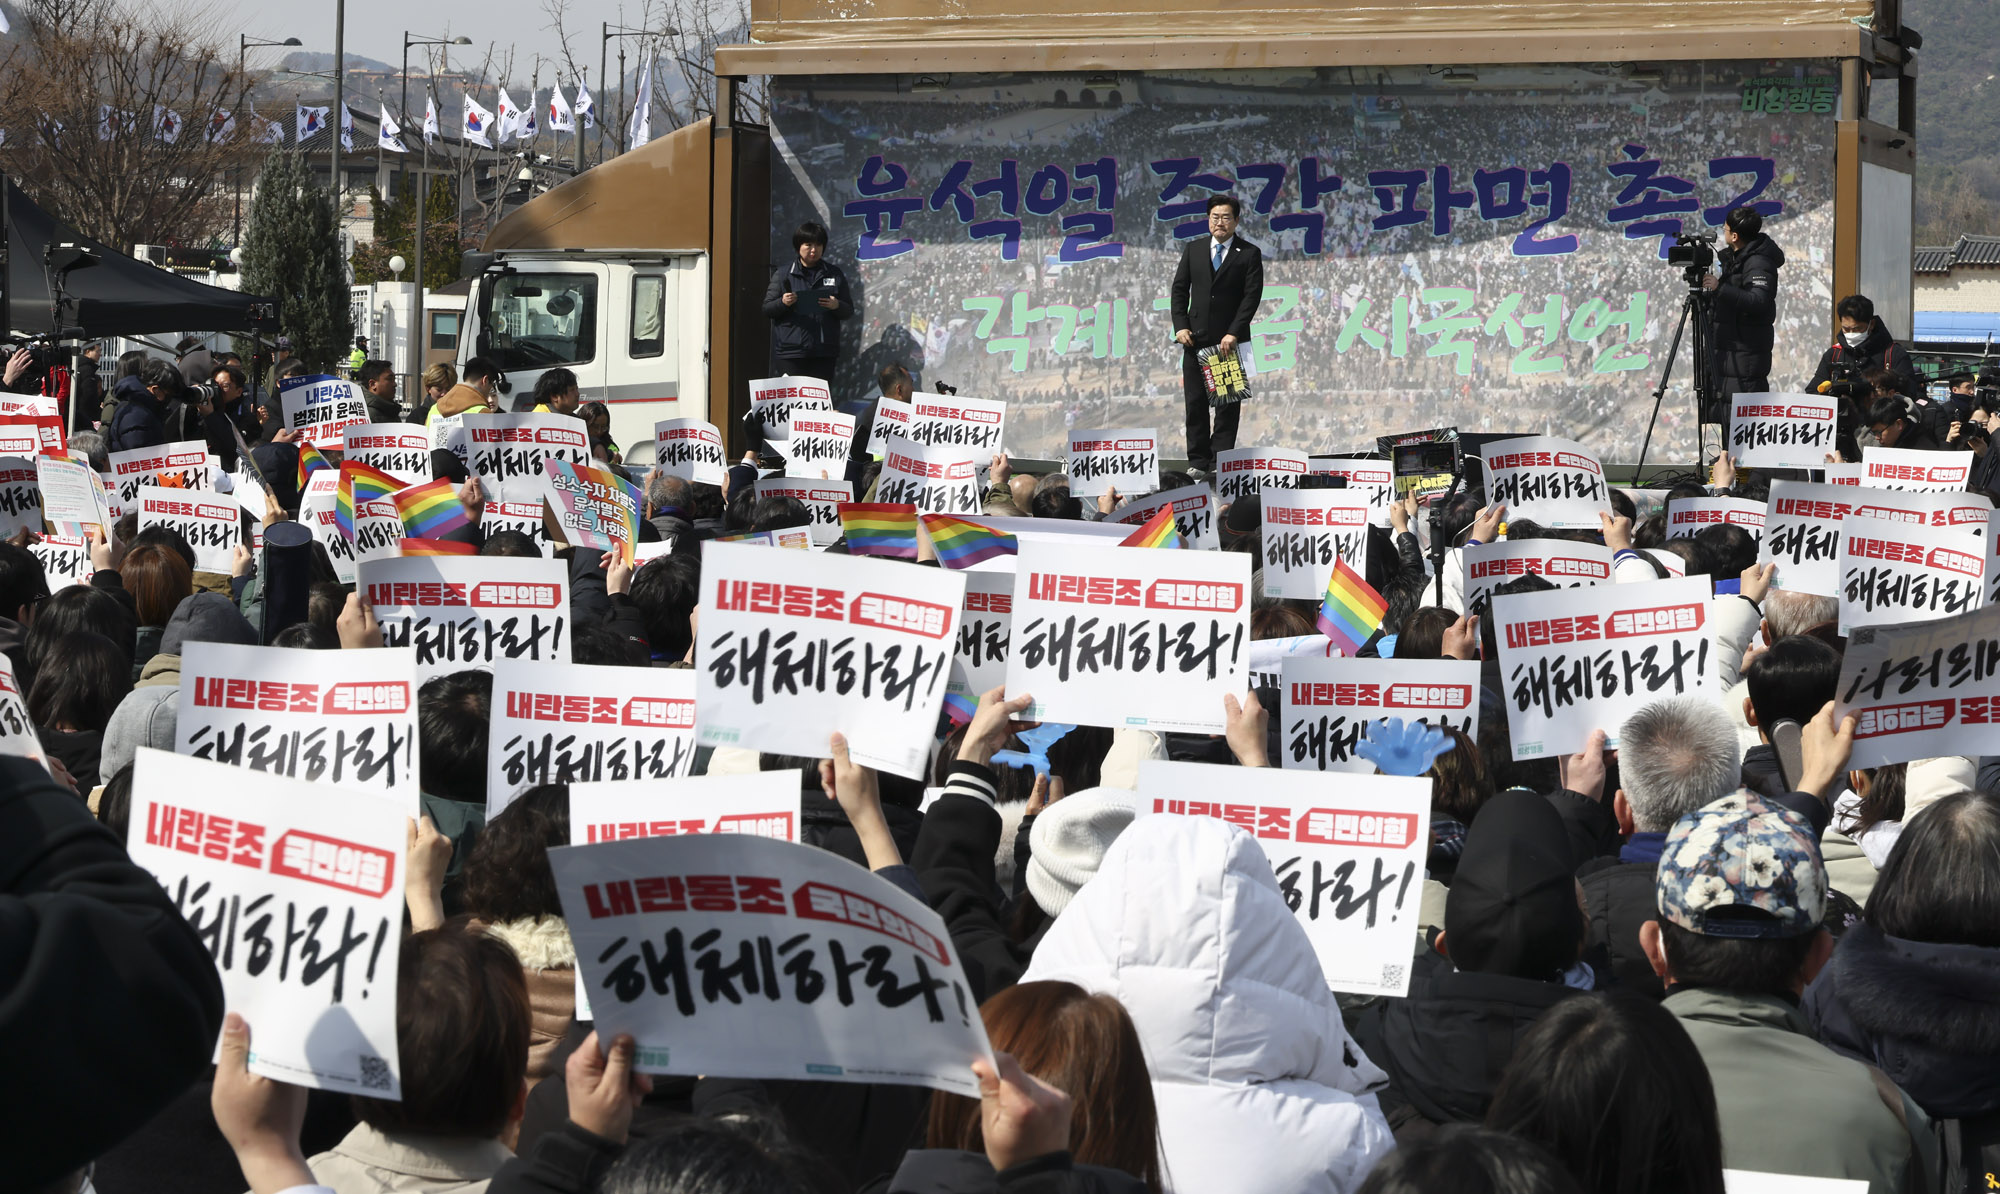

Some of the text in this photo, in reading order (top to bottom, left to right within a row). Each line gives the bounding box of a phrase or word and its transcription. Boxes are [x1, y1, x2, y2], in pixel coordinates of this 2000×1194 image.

[843, 154, 1125, 262] 윤석열
[1368, 161, 1580, 258] 파면
[962, 289, 1130, 372] 각계
[1152, 284, 1306, 373] 급
[306, 384, 352, 406] 내란수괴
[755, 387, 797, 401] 내란동조
[293, 401, 366, 427] 범죄자 윤석열
[880, 407, 910, 424] 내란동
[916, 404, 960, 420] 내란동조
[1736, 405, 1830, 419] 내란동조 국민의힘
[471, 428, 583, 445] 내란동조 국민의힘
[658, 428, 698, 442] 내란동조
[793, 420, 831, 434] 내란동조
[912, 421, 1000, 448] 해체하라!
[1733, 422, 1834, 450] 해체하라!
[348, 435, 397, 449] 내란동조
[1072, 440, 1113, 452] 내란동조
[116, 457, 164, 475] 내란동조
[887, 451, 944, 479] 내란동조
[1072, 453, 1155, 481] 해체하라!
[1221, 458, 1266, 473] 내란동조
[1489, 452, 1552, 471] 내란동조
[1868, 463, 1925, 481] 내란동조
[552, 473, 637, 515] 성소수자 차별도
[1490, 472, 1606, 507] 해체하라!
[144, 499, 193, 516] 내란동조
[573, 494, 624, 523] 윤석열도
[1266, 506, 1323, 526] 내란동조
[1672, 510, 1723, 524] 내란동조
[1775, 498, 1852, 520] 내란동조
[563, 512, 593, 532] 없는
[594, 518, 629, 544] 사회로
[1470, 558, 1607, 579] 내란동조 국민의힘
[1848, 536, 1925, 565] 내란동조
[1933, 549, 1981, 576] 국민의힘
[368, 583, 554, 606] 내란동조 국민의힘
[1028, 572, 1236, 609] 내란동조 국민의힘
[715, 579, 946, 636] 내란동조 국민의힘
[1505, 606, 1698, 649] 내란동조 국민의힘
[1020, 614, 1244, 682] 해체하라!
[708, 627, 946, 713] 해체하라!
[1511, 638, 1709, 719] 해체하라!
[193, 676, 406, 713] 내란동조 국민의힘
[506, 691, 696, 725] 내란동조 국민의힘
[1291, 683, 1465, 706] 내란동조 국민의힘
[1307, 811, 1408, 845] 국민의힘
[145, 801, 388, 894] 내란동조 국민의힘
[583, 874, 946, 959] 내란동조 국민의힘
[154, 874, 389, 1005] 체하라!
[598, 927, 970, 1027] 해체하라!
